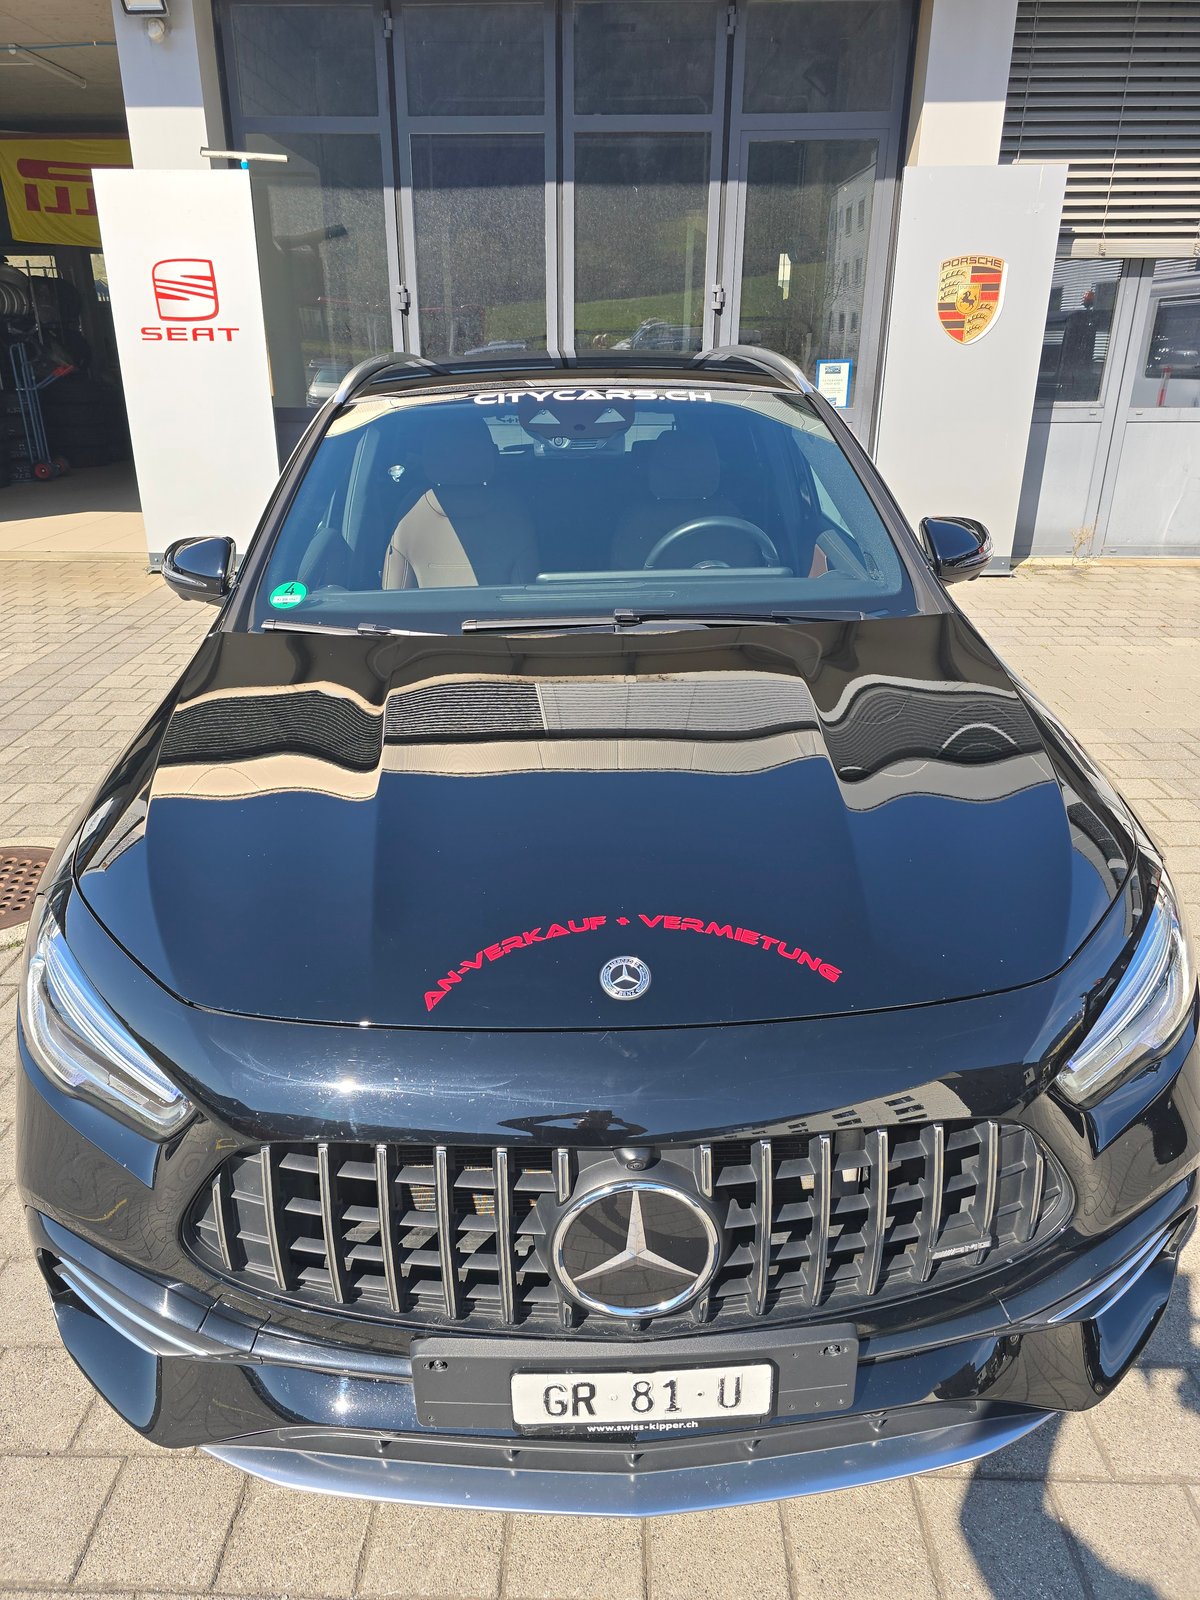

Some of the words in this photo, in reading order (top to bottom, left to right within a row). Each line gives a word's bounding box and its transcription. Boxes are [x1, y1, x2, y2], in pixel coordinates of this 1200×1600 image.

[942, 256, 1002, 270] PORSCHE
[141, 327, 239, 341] SEAT
[473, 389, 711, 404] CITYCARS.CH
[284, 583, 295, 595] 4
[424, 916, 606, 1012] AN-VERKAUF
[616, 917, 630, 926] +
[638, 914, 843, 983] VERMIETUNG
[543, 1382, 597, 1417] GR
[631, 1377, 682, 1414] 81
[716, 1373, 743, 1409] U
[587, 1420, 699, 1433] www.swiss-kipper.ch
